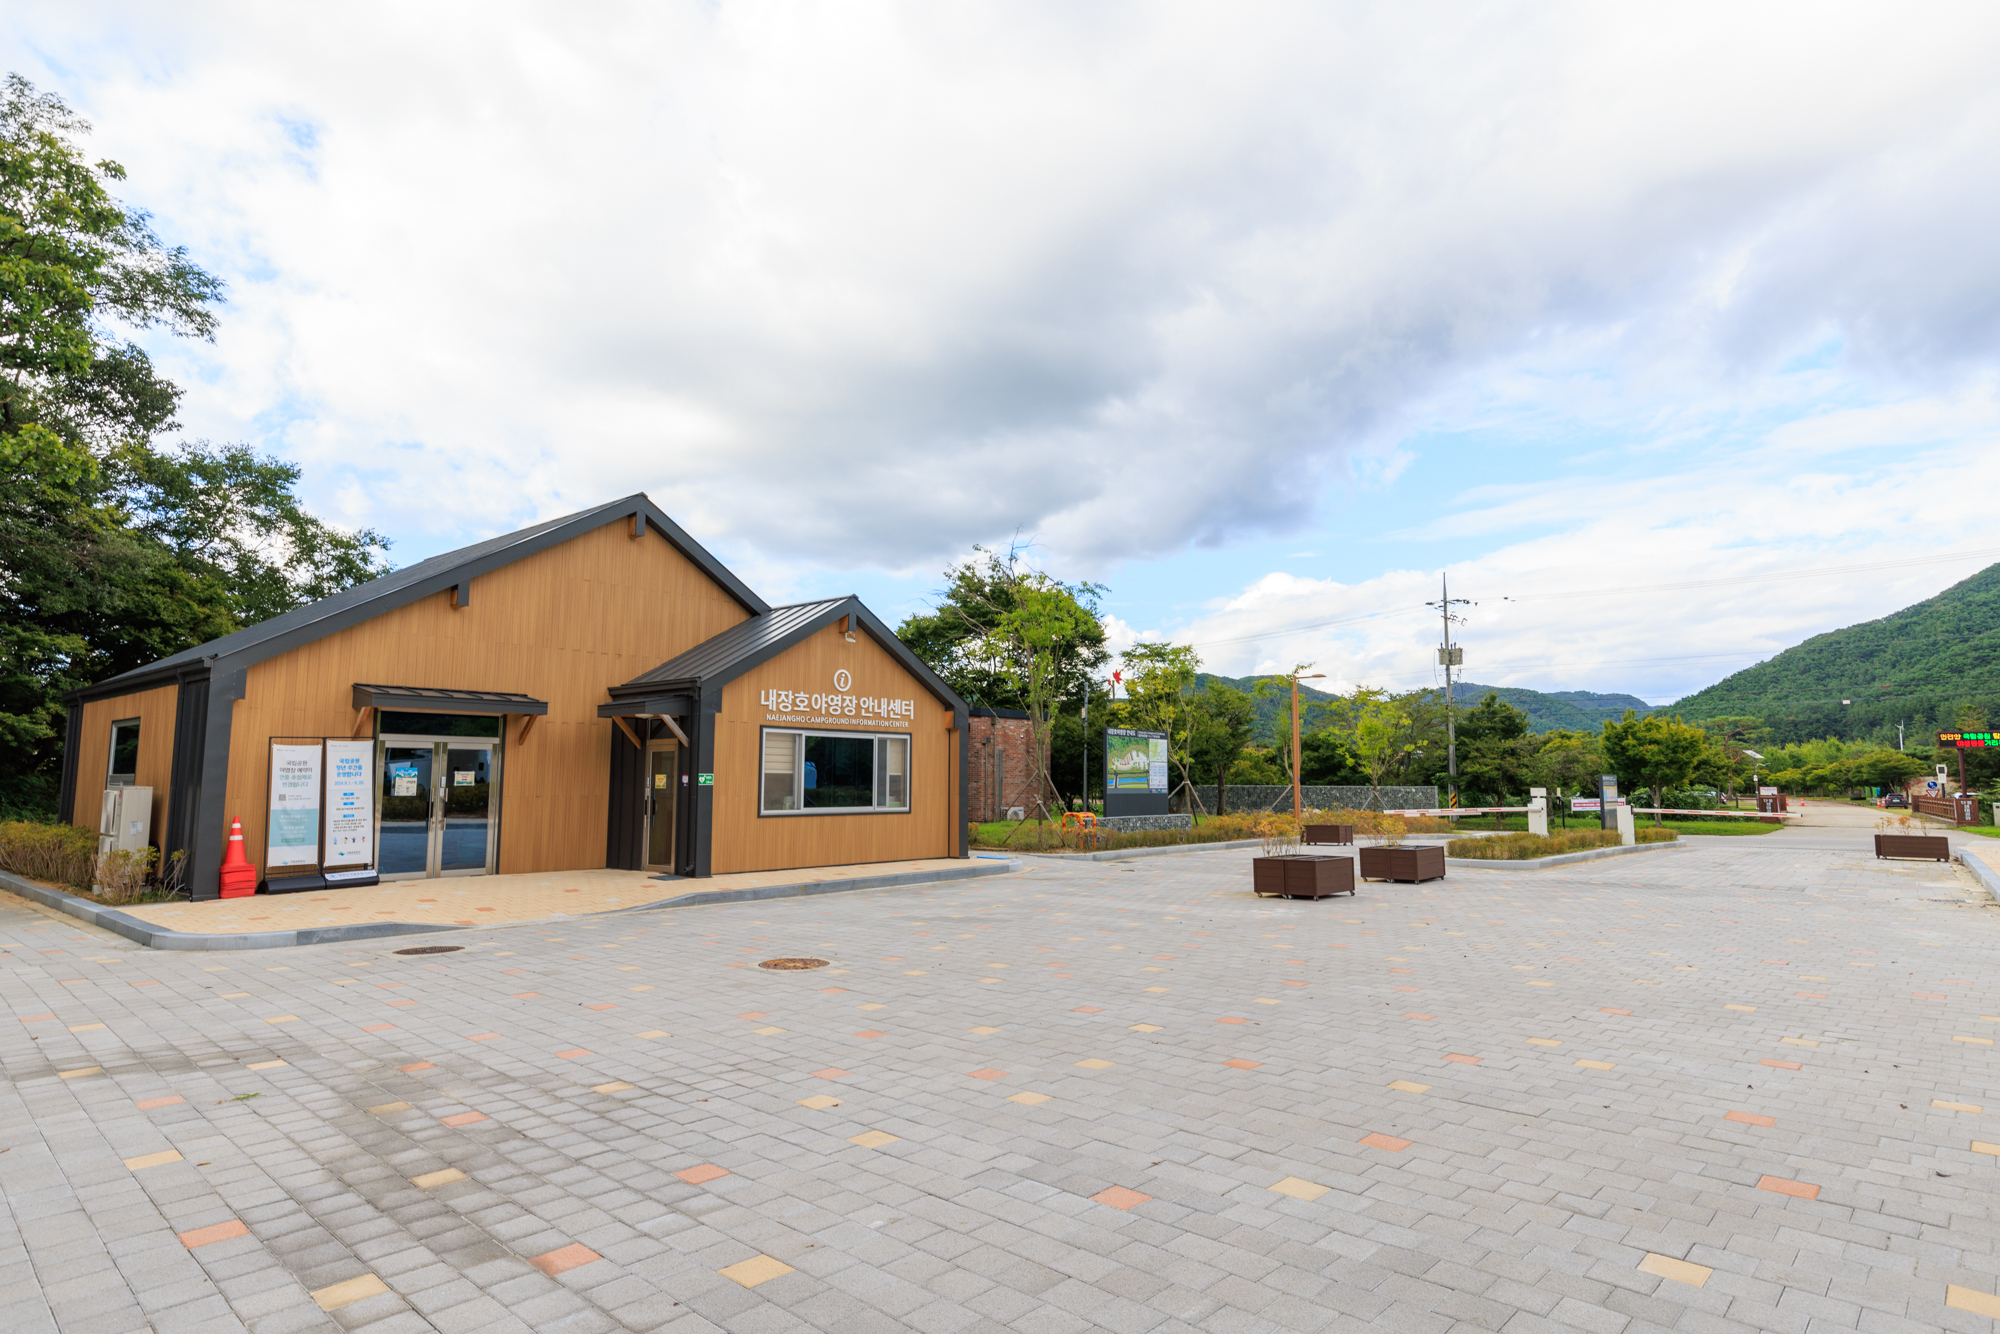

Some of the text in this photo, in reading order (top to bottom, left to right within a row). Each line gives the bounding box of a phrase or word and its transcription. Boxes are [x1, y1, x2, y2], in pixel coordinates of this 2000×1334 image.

[761, 689, 914, 720] 내장호 야영장 안내센터
[766, 714, 805, 723] NAEJANGHO
[806, 716, 849, 725] CAMPGROUND
[850, 718, 889, 727] INFORMATION
